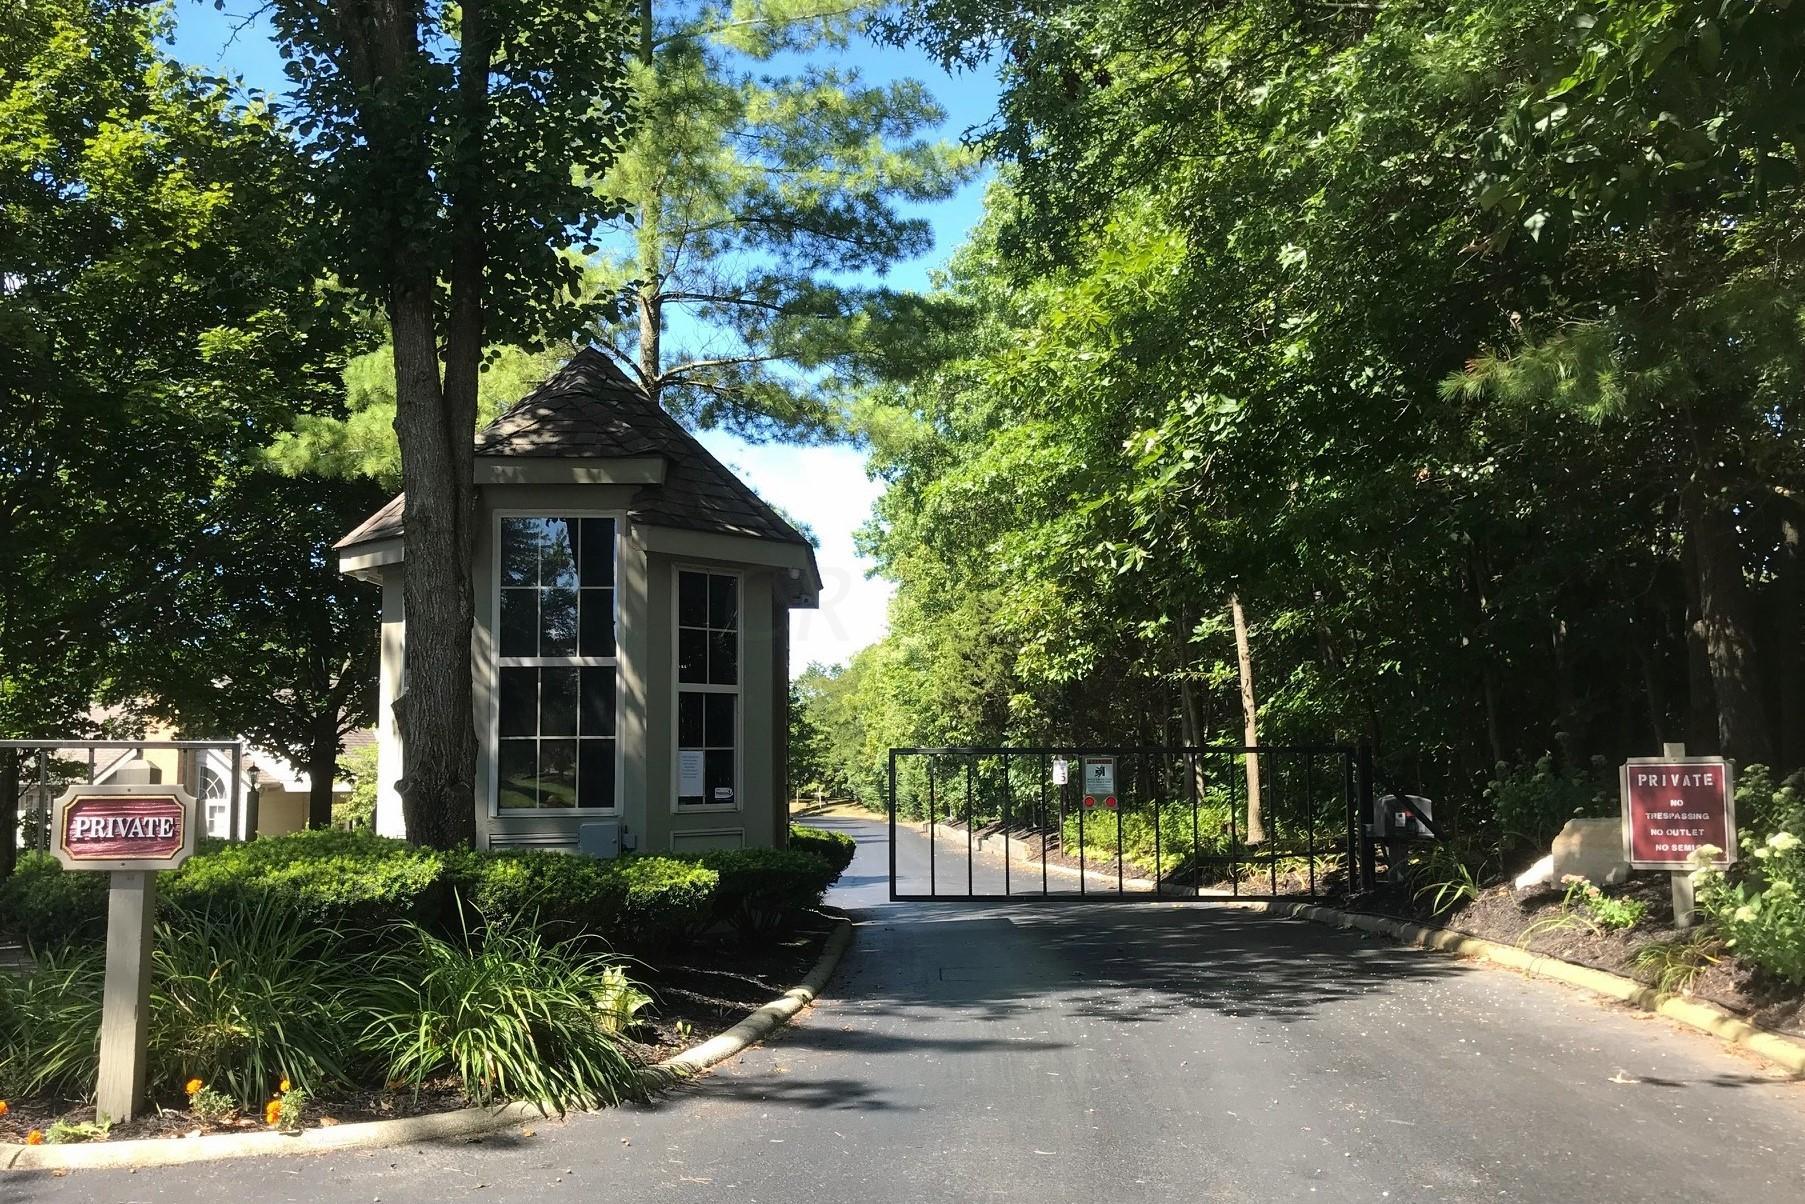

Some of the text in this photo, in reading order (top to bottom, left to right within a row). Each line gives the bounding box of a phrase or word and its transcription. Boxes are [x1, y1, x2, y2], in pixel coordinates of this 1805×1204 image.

[1638, 773, 1714, 787] PRIVATE
[1670, 799, 1684, 807] NO
[1645, 812, 1710, 820] TRESPASSING
[73, 816, 174, 838] PRIVATE
[1650, 828, 1705, 836] NO OUTLET
[1655, 844, 1669, 852] NO
